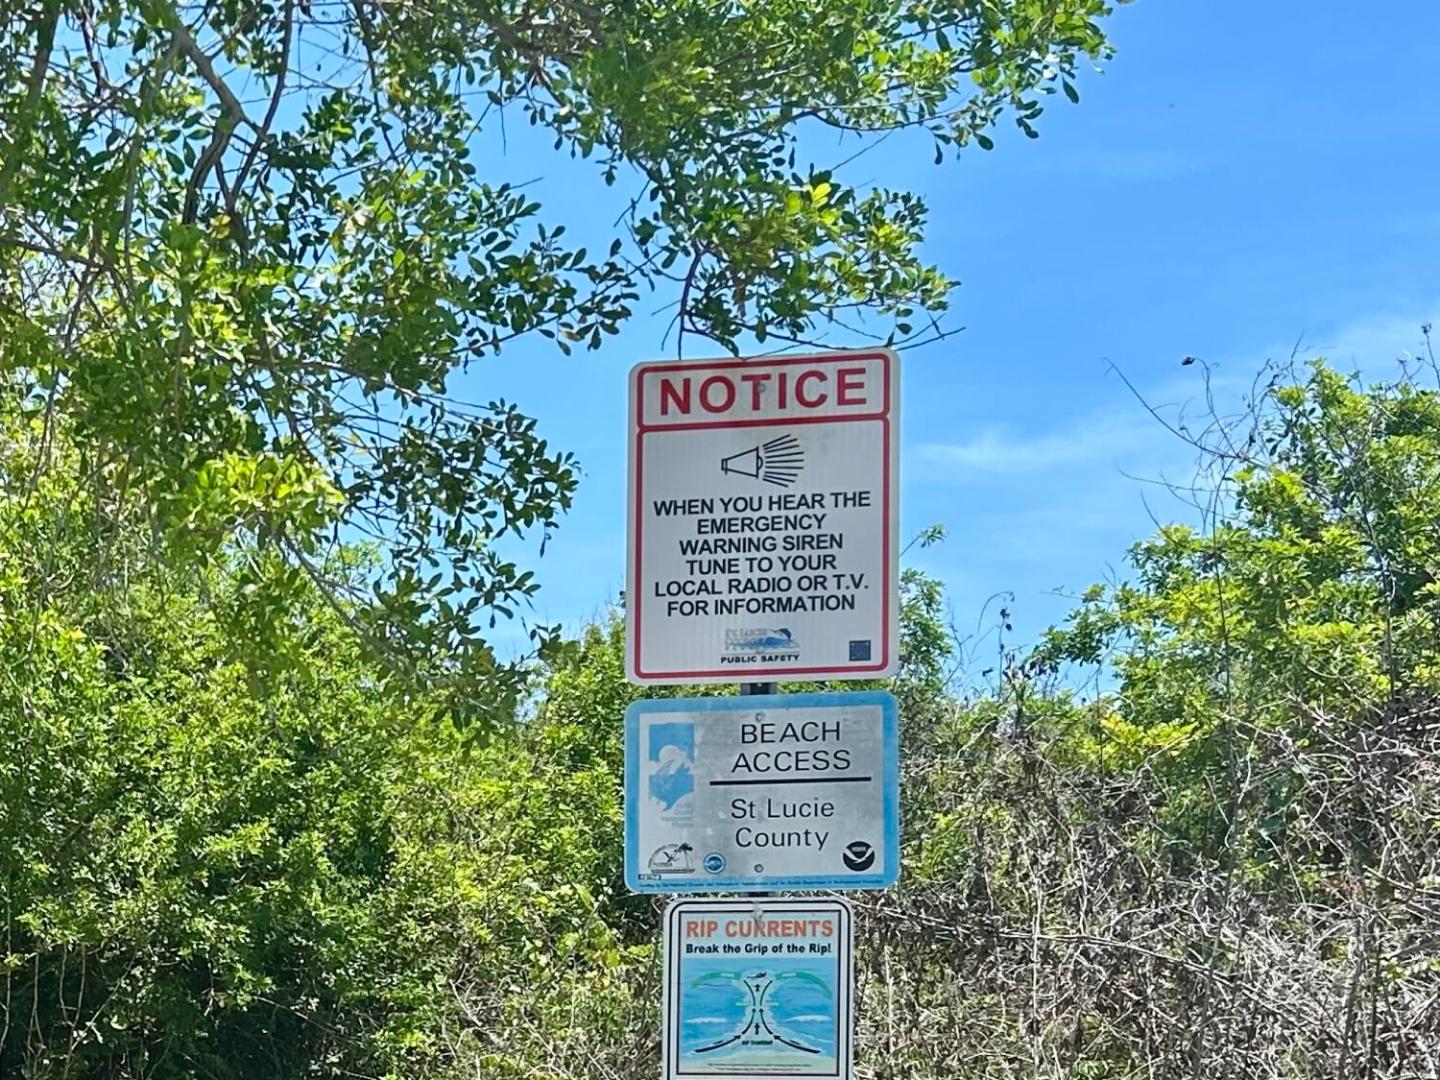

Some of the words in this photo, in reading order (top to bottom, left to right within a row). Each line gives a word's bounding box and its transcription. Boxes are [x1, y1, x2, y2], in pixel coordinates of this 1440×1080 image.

[660, 368, 867, 416] NOTICE
[654, 500, 713, 516] WHEN
[720, 497, 762, 514] YOU
[768, 494, 824, 510] HEAR
[830, 491, 871, 507] THE
[697, 514, 826, 535] EMERGENCY
[680, 537, 776, 556] WARNING
[782, 534, 843, 551] SIREN
[686, 559, 740, 575] TUNE
[746, 557, 773, 573] TO
[779, 554, 837, 571] YOUR
[655, 580, 722, 597] LOCAL
[728, 577, 792, 594] RADIO
[798, 575, 827, 591] OR
[833, 574, 868, 590] T.V.
[668, 600, 708, 617] FOR
[714, 595, 855, 615] INFORMATION
[721, 655, 757, 663] PUBLIC
[761, 654, 800, 662] SAFETY
[741, 722, 841, 744] BEACH
[731, 750, 851, 773] ACCESS
[731, 799, 756, 819] St
[768, 799, 835, 818] Lucie
[736, 827, 829, 850] County
[686, 921, 718, 937] RIP
[725, 920, 833, 937] CURRENTS
[686, 944, 719, 953] Break
[723, 944, 741, 953] the
[745, 944, 768, 955] Grip
[772, 944, 783, 953] of
[787, 943, 805, 953] the
[810, 944, 831, 955] Rip!
